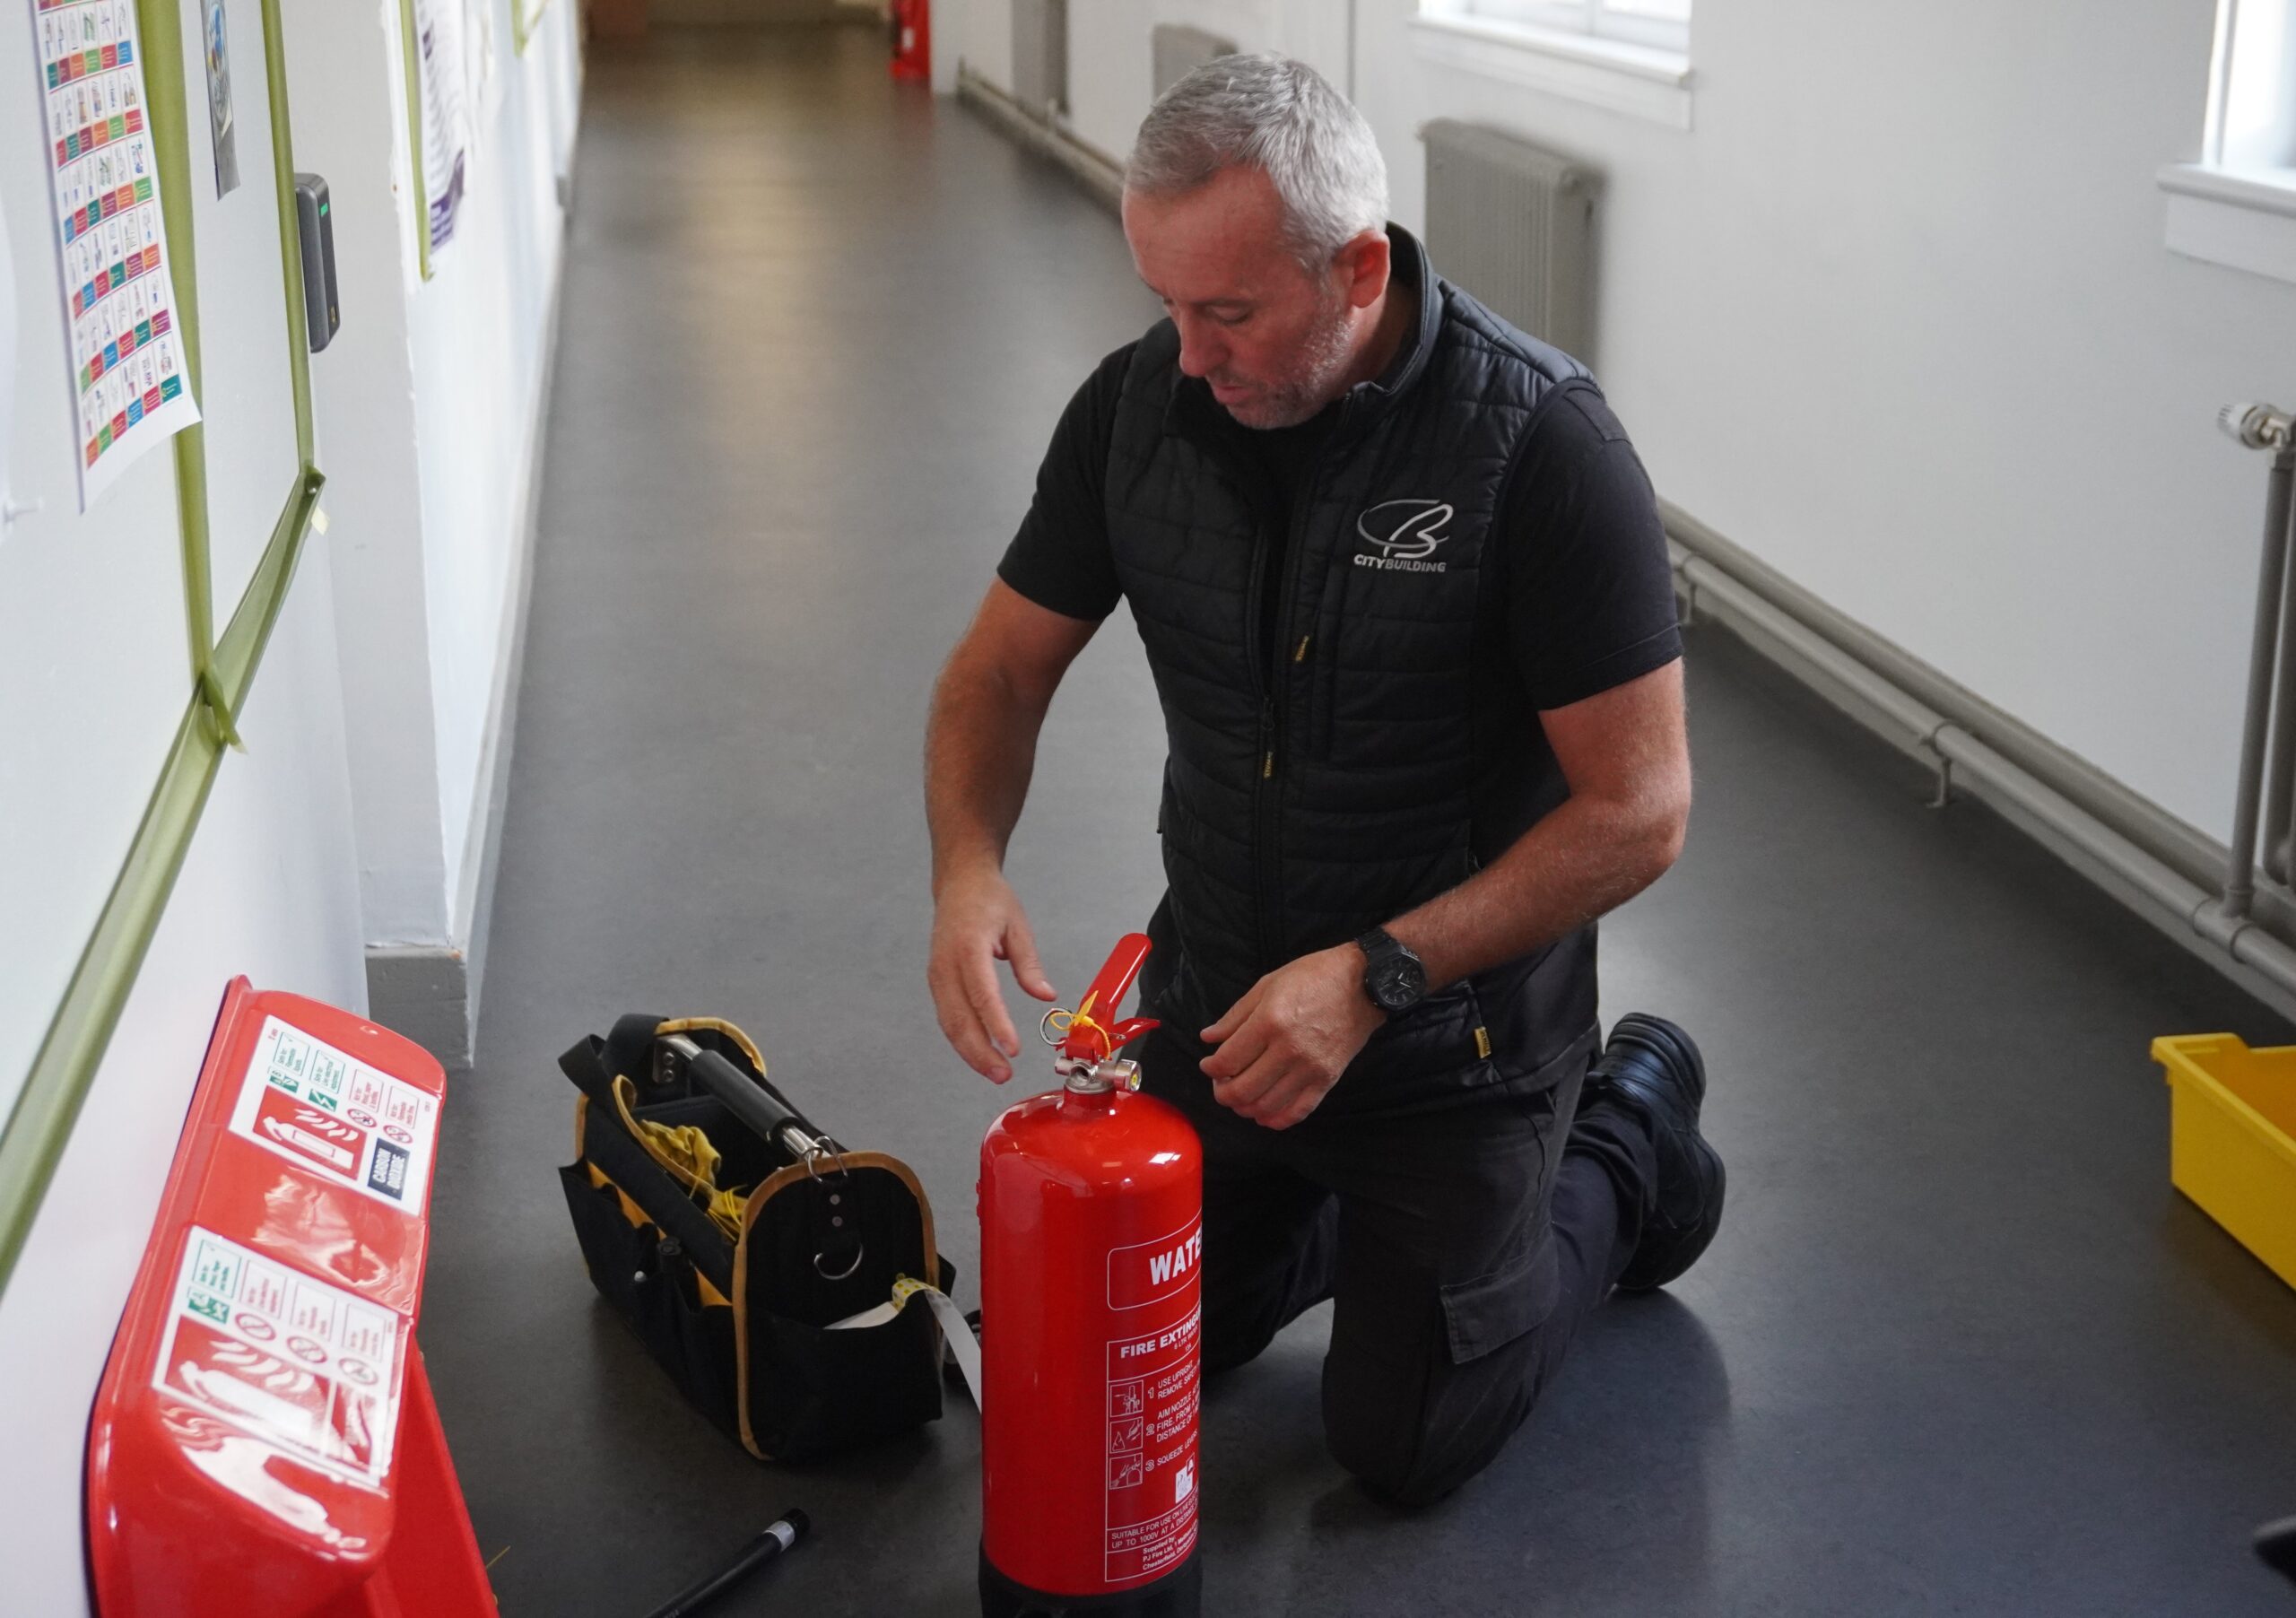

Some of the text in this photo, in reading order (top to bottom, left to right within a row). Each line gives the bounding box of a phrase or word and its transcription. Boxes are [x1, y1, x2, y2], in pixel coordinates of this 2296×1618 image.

[1120, 1302, 1201, 1359] FIRE EXTINGU
[1158, 1376, 1171, 1389] USE
[1158, 1379, 1183, 1399] REMOVE
[1157, 1407, 1170, 1420] AIM
[1171, 1391, 1192, 1414] NOZZLE
[1176, 1403, 1191, 1422] FROM
[1146, 1423, 1154, 1436] 2
[1157, 1418, 1187, 1442] DISTANCE
[1157, 1445, 1184, 1466] SQUEEZE
[1111, 1527, 1145, 1540] SUITABLE
[1146, 1521, 1160, 1532] FOR
[1160, 1516, 1172, 1526] USE
[1112, 1541, 1123, 1549] UP
[1126, 1538, 1136, 1546] TO
[1140, 1530, 1159, 1543] 1000V
[1161, 1526, 1169, 1535] AT
[1143, 1538, 1167, 1554] Supplied
[1143, 1554, 1152, 1562] PJ
[1152, 1550, 1163, 1560] Fire
